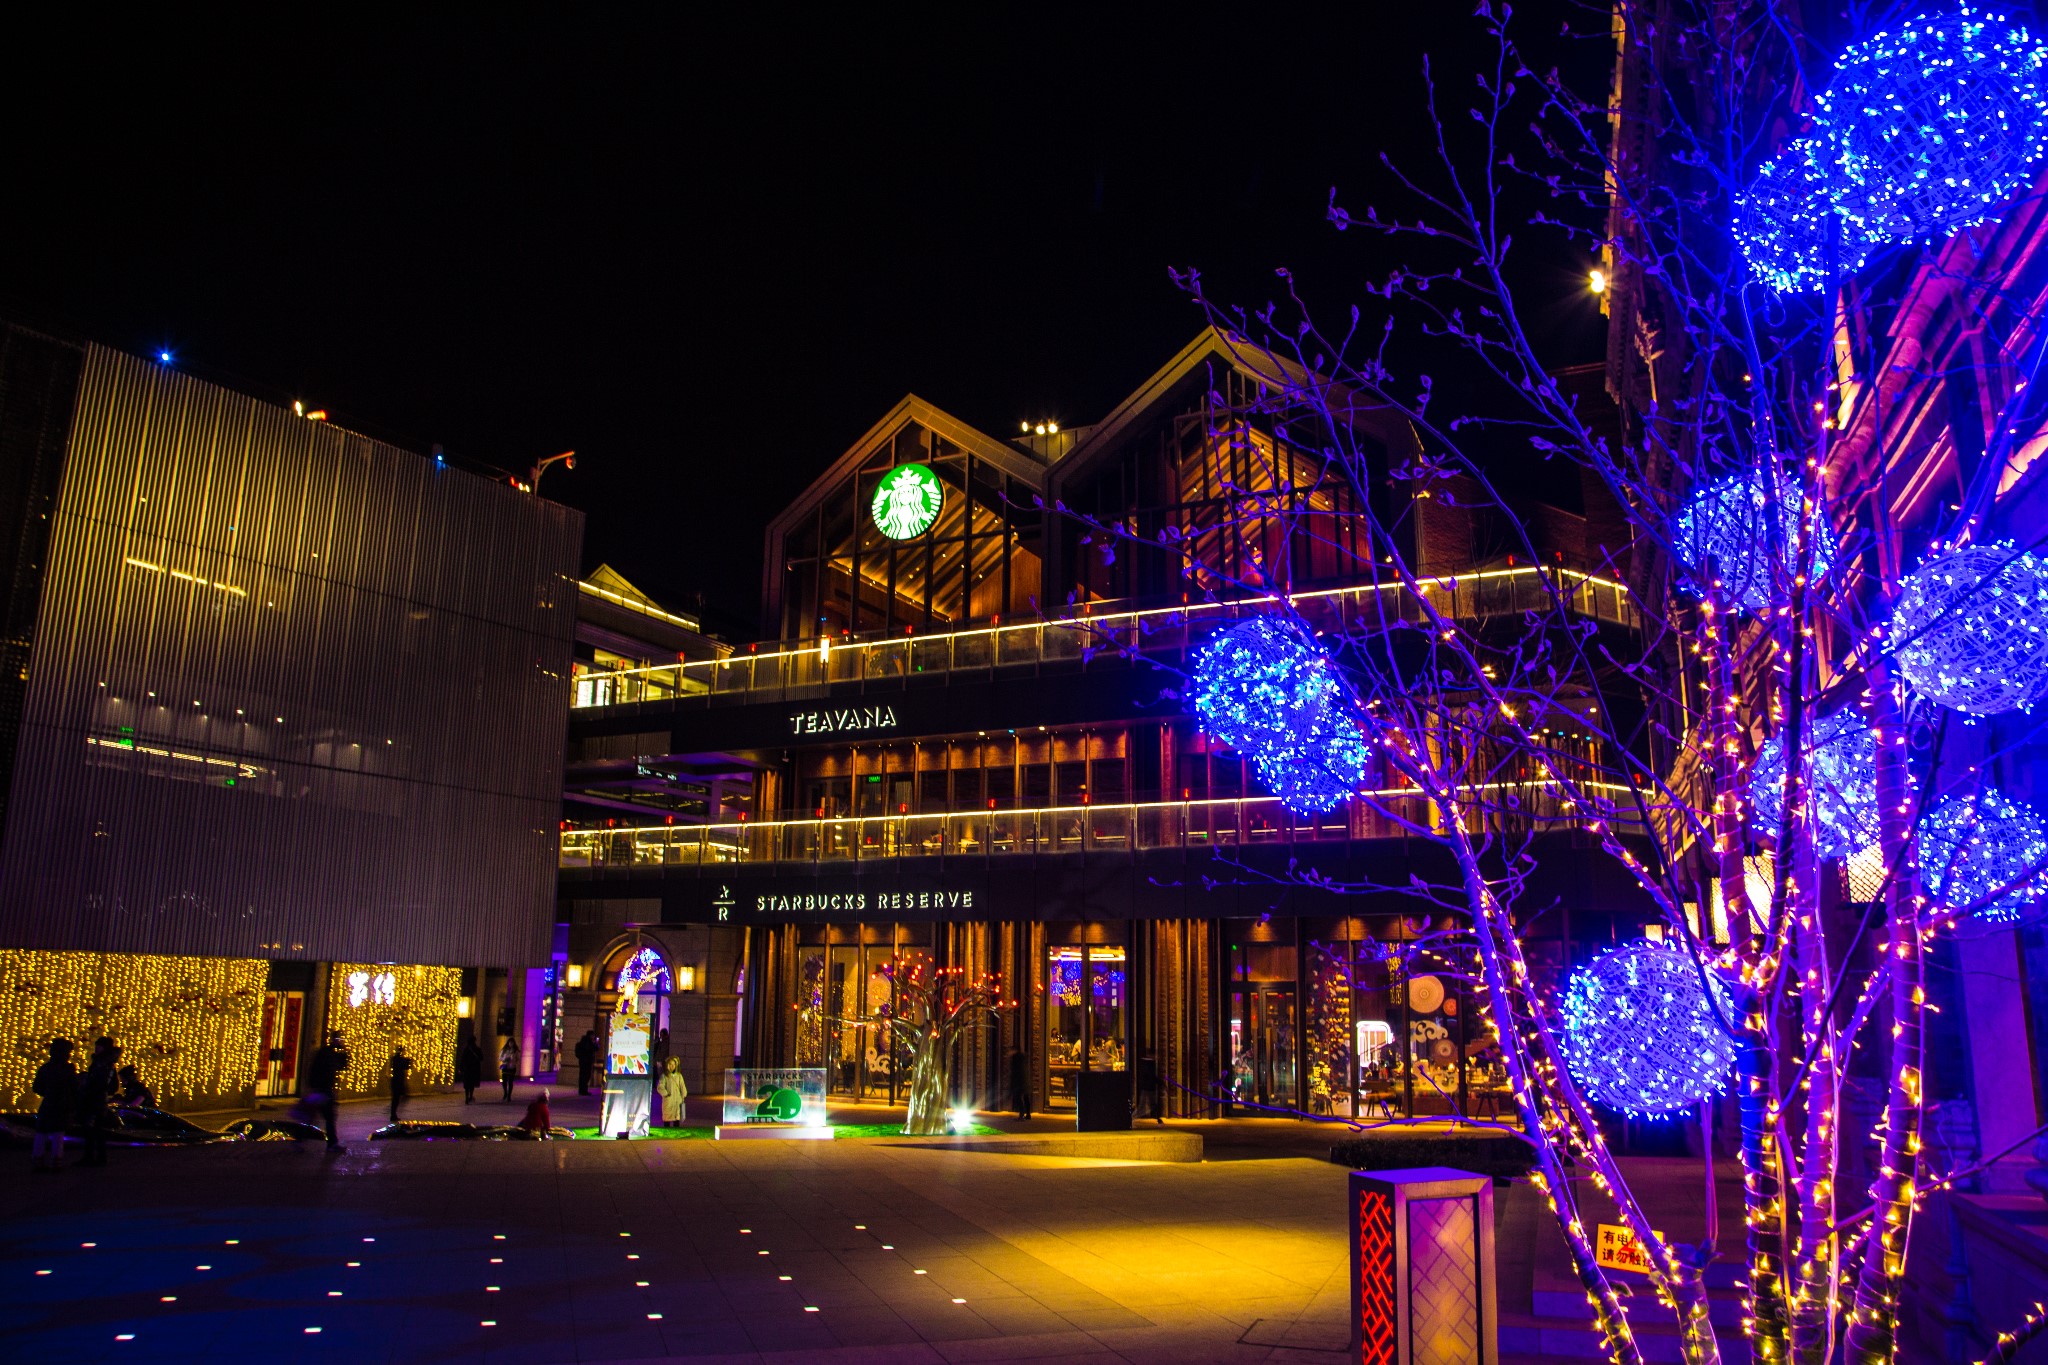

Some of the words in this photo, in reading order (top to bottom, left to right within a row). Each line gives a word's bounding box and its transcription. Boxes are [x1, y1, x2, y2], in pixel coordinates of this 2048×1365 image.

[789, 705, 897, 735] TEAVANA
[756, 893, 867, 912] STARBUCKS
[877, 891, 973, 910] RESERVE
